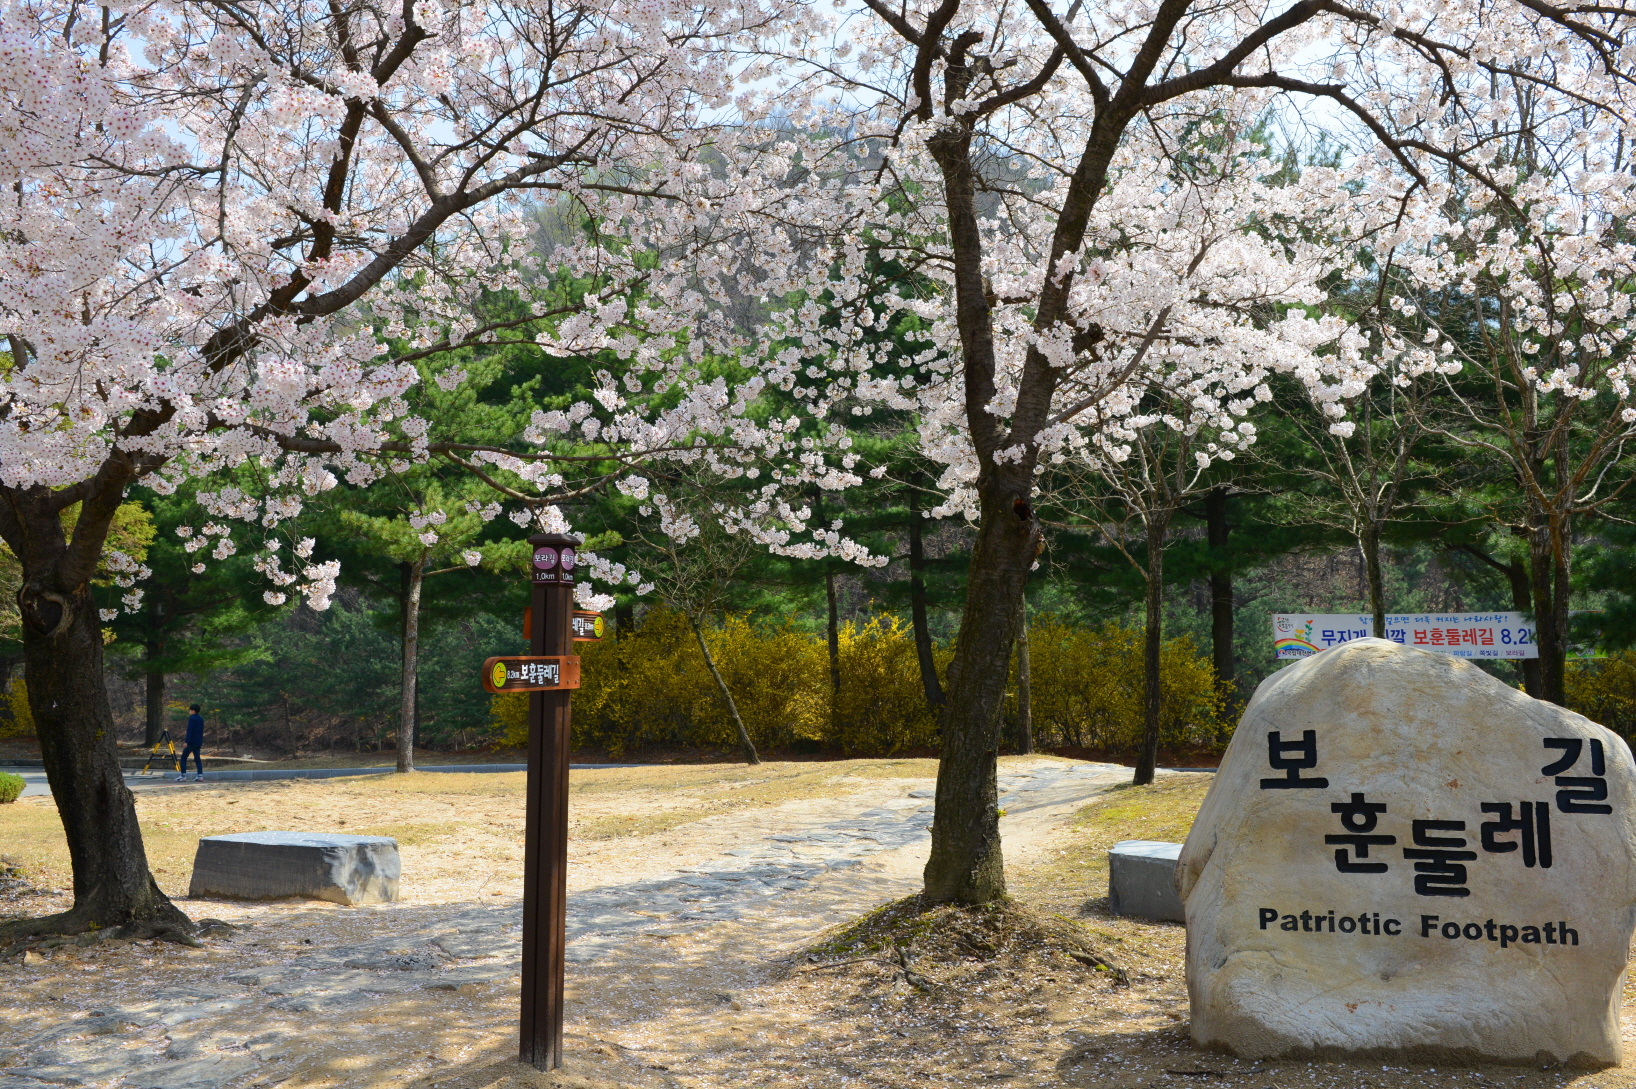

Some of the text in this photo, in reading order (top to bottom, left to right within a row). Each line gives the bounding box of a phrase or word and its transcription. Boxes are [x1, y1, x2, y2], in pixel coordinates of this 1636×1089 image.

[535, 554, 555, 565] 보라길
[1385, 616, 1410, 625] 걸으면
[1463, 614, 1508, 624] 나라사랑!
[1321, 629, 1367, 646] 무지개
[1384, 628, 1406, 645] 깔
[1413, 627, 1495, 646] 보훈둘레길
[521, 663, 559, 684] 보훈둘레길
[1259, 729, 1613, 898] 보훈둘레길
[1258, 907, 1580, 948] Patriotic Footpath
